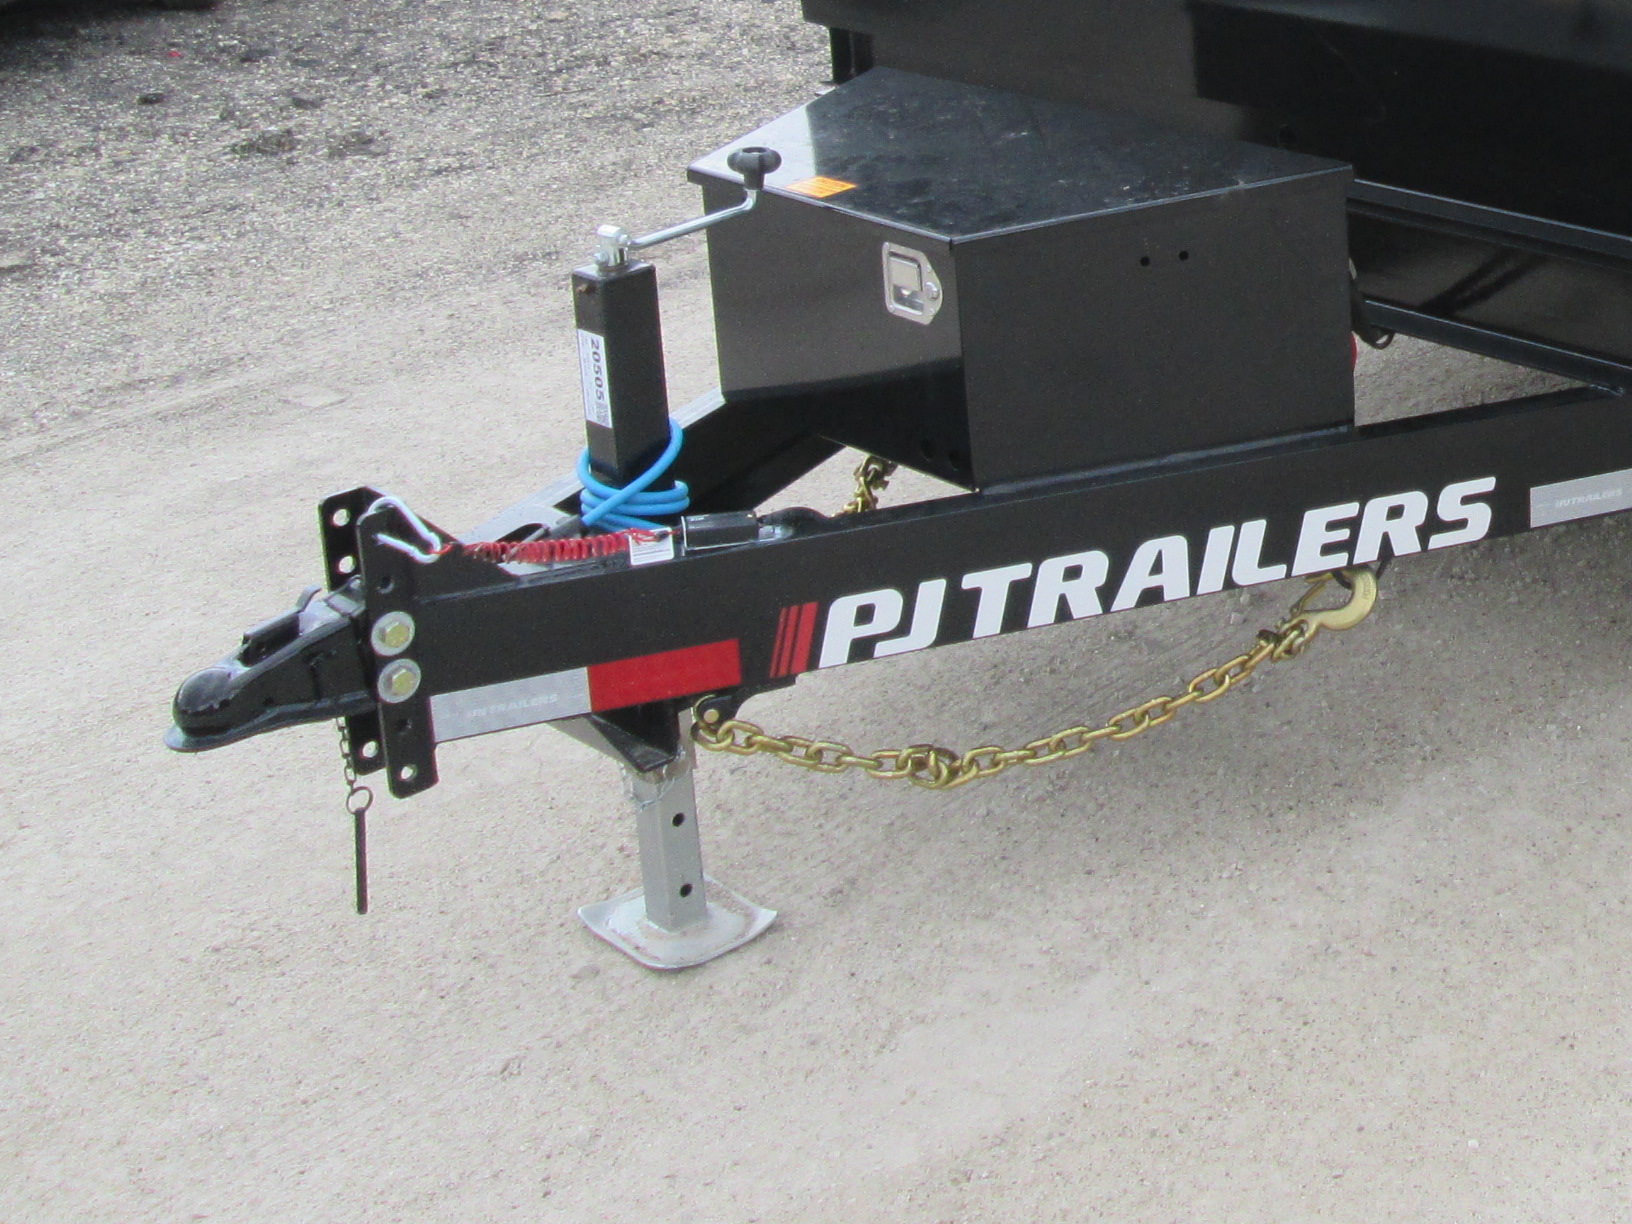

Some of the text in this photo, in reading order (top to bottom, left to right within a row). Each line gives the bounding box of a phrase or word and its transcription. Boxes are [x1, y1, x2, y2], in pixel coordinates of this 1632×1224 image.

[590, 337, 605, 402] 20505
[818, 476, 1497, 669] PJ TRAILERS
